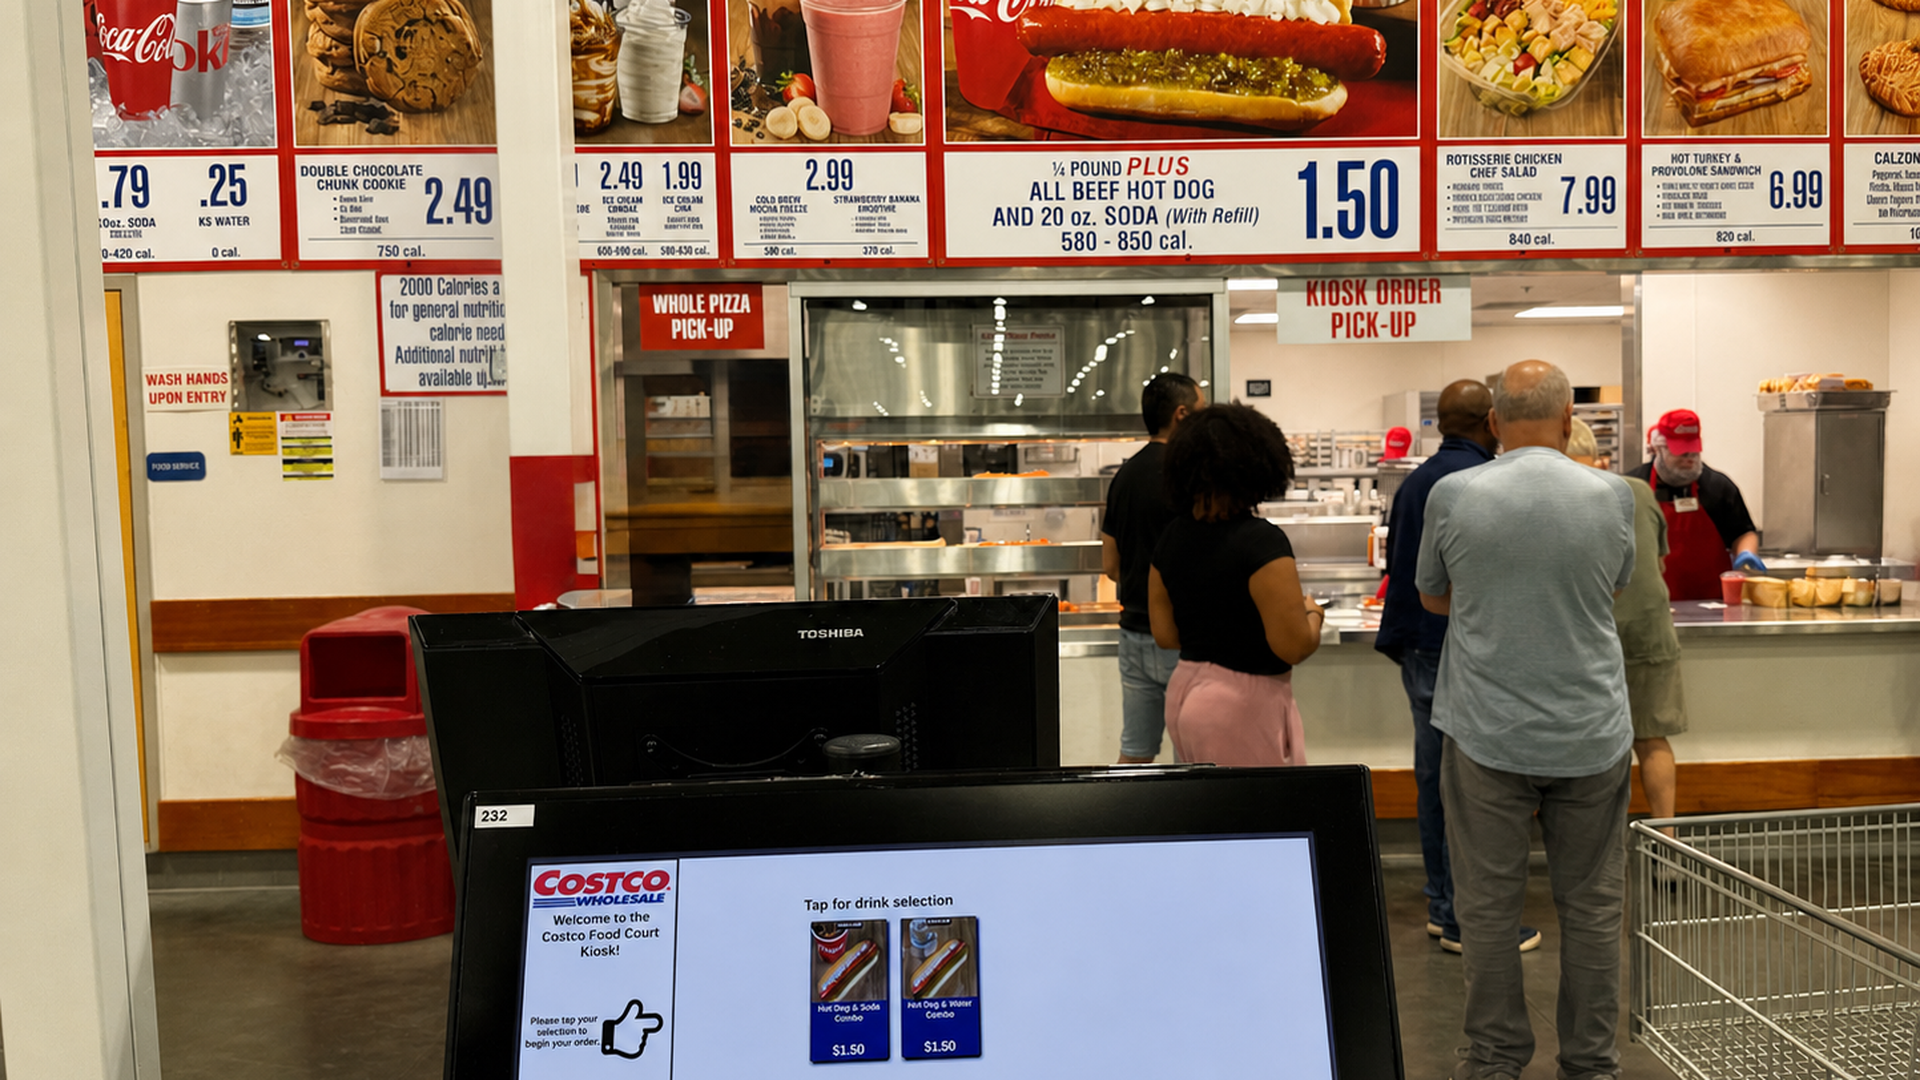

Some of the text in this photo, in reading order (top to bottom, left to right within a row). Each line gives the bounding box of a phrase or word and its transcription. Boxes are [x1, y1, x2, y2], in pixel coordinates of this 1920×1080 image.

[1446, 153, 1562, 166] ROTISSERIE CHICKEN
[1671, 153, 1741, 164] HOT TURKEY &
[300, 164, 423, 177] DOUBLE CHOCOLATE
[1071, 161, 1122, 176] POUND
[1127, 156, 1190, 176] PLUS
[1470, 166, 1537, 178] CHEF SALAD
[1652, 165, 1761, 176] PROVOLONE SANDWICH
[600, 161, 643, 190] 2.49
[662, 161, 702, 190] 1.99
[806, 158, 853, 191] 2.99
[102, 165, 150, 208] .79
[200, 164, 248, 207] .25
[317, 178, 406, 191] CHUNK COOKIE
[1029, 179, 1215, 201] ALL BEEF HOT DOG
[1770, 170, 1823, 209] 6.99
[425, 177, 493, 225] 2.49
[755, 196, 775, 204] COLD
[1298, 158, 1399, 239] 1.50
[1560, 176, 1616, 215] 7.99
[128, 218, 156, 228] SODA
[199, 216, 250, 227] KS WATER
[992, 206, 1260, 228] AND 20 oz. SODA (With Refill)
[1061, 231, 1097, 251] 580
[1118, 231, 1152, 250] 850
[1159, 230, 1192, 249] cal.
[1509, 233, 1555, 245] 840 cal.
[1716, 230, 1755, 242] 820 cal.
[135, 248, 155, 259] cal.
[212, 247, 241, 258] 0 cal.
[377, 245, 426, 257] 750 cal.
[781, 247, 797, 256] cal.
[880, 246, 895, 256] cal.
[400, 277, 500, 296] 2000 Calories a
[1306, 278, 1442, 307] KIOSK ORDER
[652, 293, 751, 314] WHOLE PIZZA
[390, 300, 409, 319] for
[413, 300, 459, 322] general
[429, 323, 472, 341] calorie
[671, 318, 734, 340] PICK-UP
[1331, 311, 1416, 339] PICK-UP
[395, 345, 455, 364] Additional
[145, 372, 228, 386] WASH HANDS
[419, 368, 472, 387] available
[149, 391, 227, 404] UPON ENTRY
[797, 628, 864, 639] TOSHIBA
[481, 810, 508, 822] 232
[533, 870, 671, 896] COSTCO
[575, 893, 665, 907] WHOLESALE
[804, 895, 954, 914] Tap for drink selection
[553, 912, 650, 926] Welcome to the
[542, 927, 660, 943] Costco Food Court
[581, 945, 620, 958] Kiosk!
[530, 1016, 599, 1026] Please tap your
[537, 1027, 588, 1037] selection to
[525, 1038, 600, 1050] begin your order.
[832, 1044, 865, 1057] $1.50
[924, 1040, 956, 1053] $1.50
